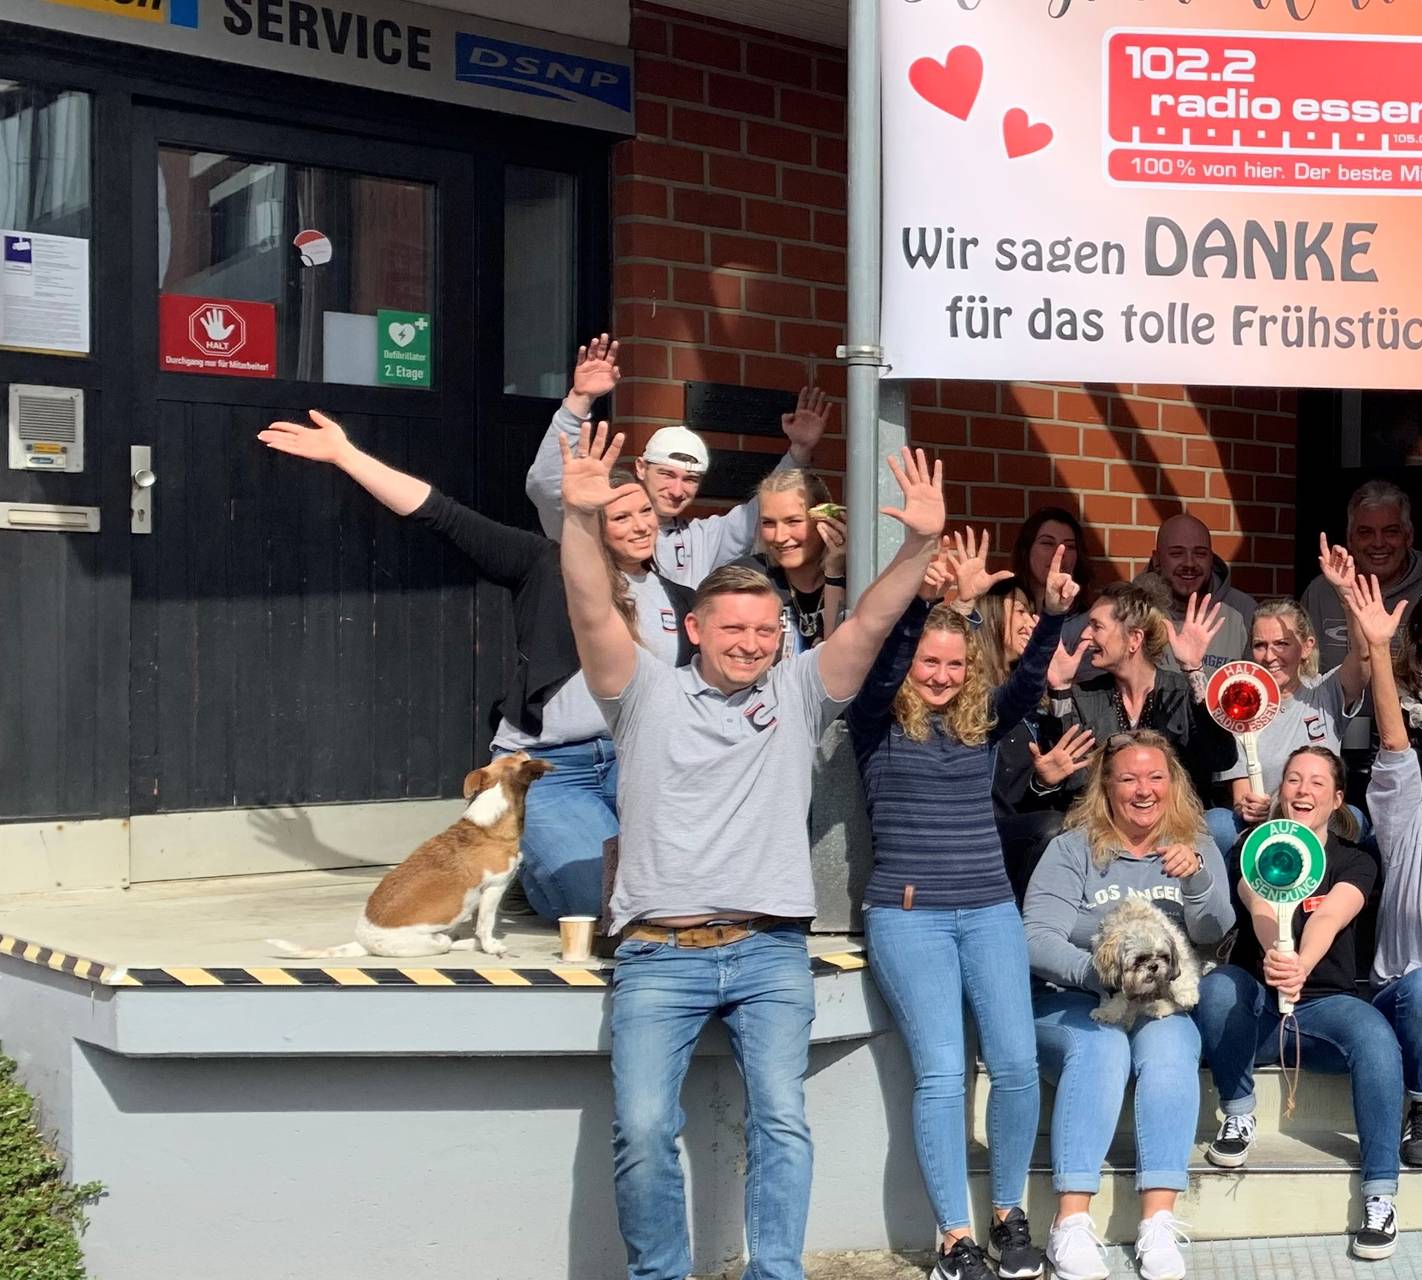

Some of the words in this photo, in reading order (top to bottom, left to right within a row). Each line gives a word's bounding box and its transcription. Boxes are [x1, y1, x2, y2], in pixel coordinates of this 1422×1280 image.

[223, 0, 431, 71] SERVICE
[468, 47, 620, 88] DSNP
[1125, 46, 1256, 82] 102.2
[1151, 88, 1281, 120] radio
[1203, 164, 1237, 178] von
[1244, 162, 1285, 179] hier.
[1294, 163, 1331, 180] Der
[1338, 165, 1393, 182] beste
[902, 227, 979, 269] Wir
[995, 236, 1125, 274] sagen
[1145, 216, 1379, 282] DANKE
[946, 295, 1013, 339] für
[1028, 298, 1104, 342] das
[1121, 302, 1215, 345] tolle
[206, 341, 229, 350] HALT
[384, 364, 394, 377] 2.
[396, 365, 424, 381] Etage
[1223, 663, 1259, 677] HALT
[1212, 707, 1246, 732] RADIO
[1249, 701, 1279, 732] ESSEN
[1269, 821, 1300, 835] AUF
[1251, 876, 1318, 902] SENDUNG
